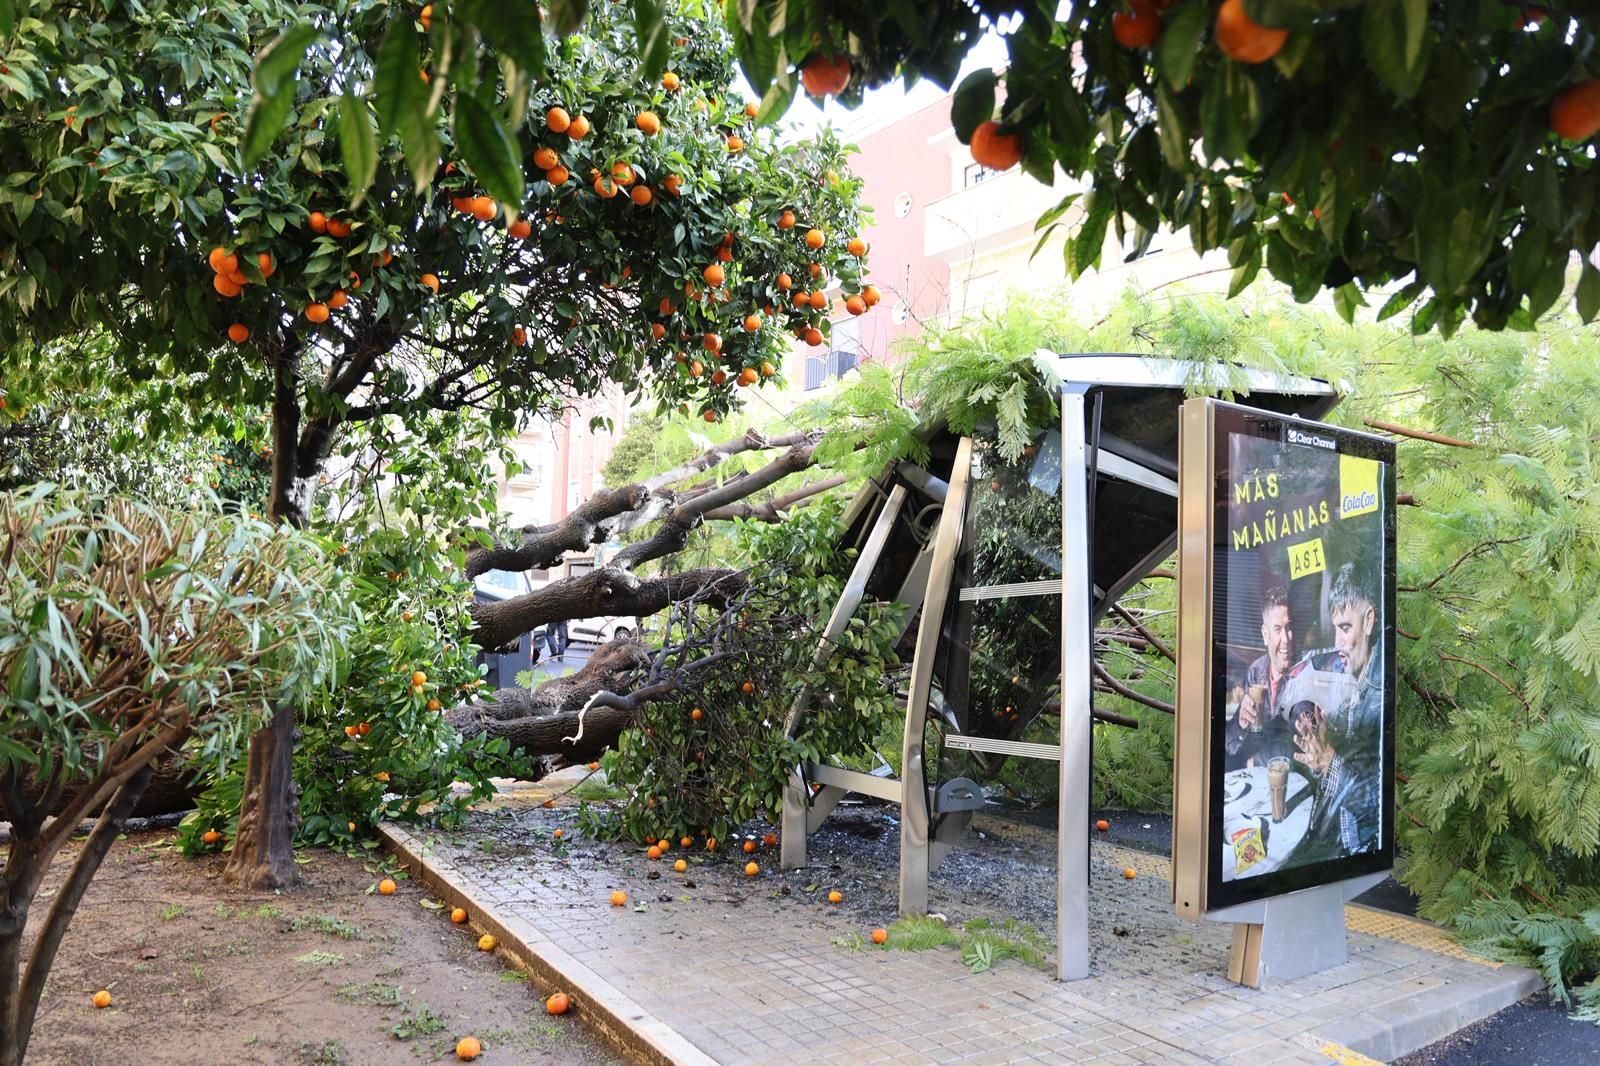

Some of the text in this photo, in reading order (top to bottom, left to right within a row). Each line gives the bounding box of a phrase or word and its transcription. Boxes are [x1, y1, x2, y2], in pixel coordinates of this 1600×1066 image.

[1297, 432, 1336, 449] Clear Channel
[1234, 469, 1279, 505] MÁS
[1343, 491, 1376, 513] ColaCao
[1232, 501, 1330, 551] MAÑANAS
[1294, 542, 1321, 573] ASÍ
